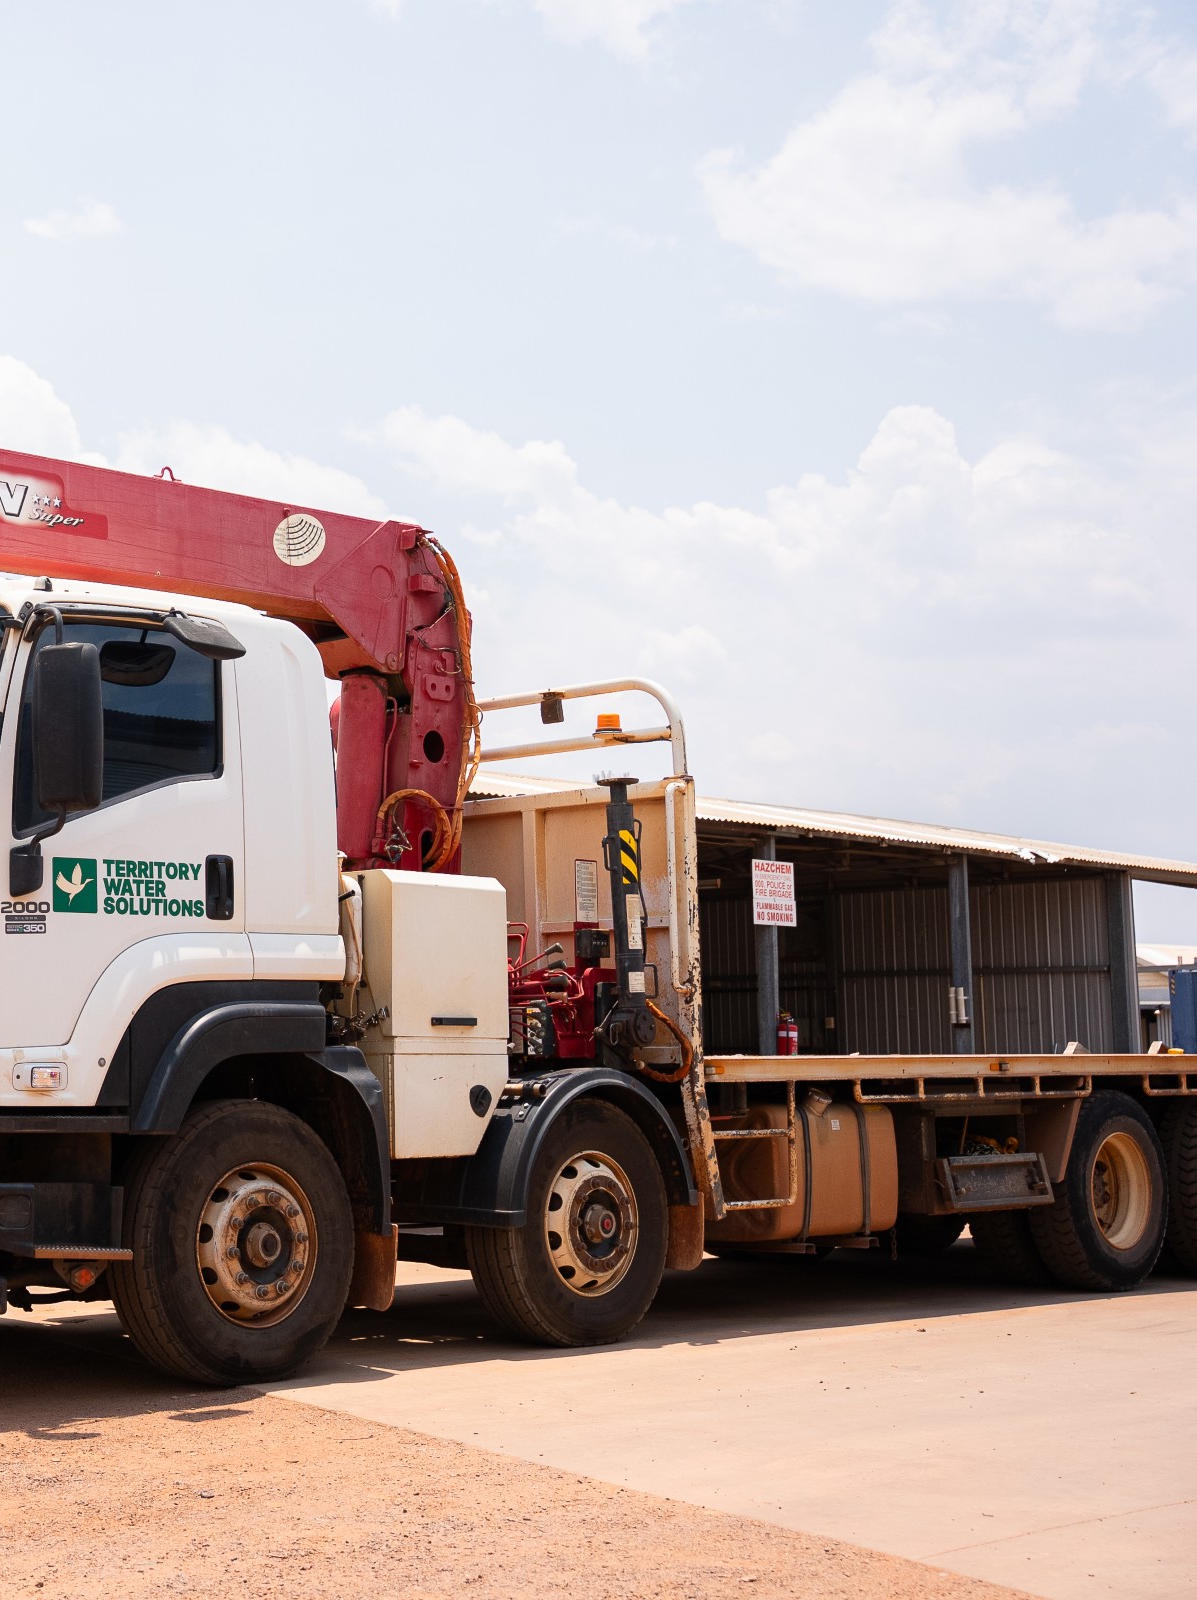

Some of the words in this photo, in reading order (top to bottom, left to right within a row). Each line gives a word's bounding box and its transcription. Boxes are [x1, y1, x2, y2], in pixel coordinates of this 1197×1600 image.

[29, 507, 84, 528] Super
[102, 859, 202, 881] TERRITORY
[754, 862, 792, 874] HAZCHEM
[103, 878, 166, 897] WATER
[767, 881, 786, 890] POLICE
[755, 888, 767, 897] FIRE
[769, 890, 792, 898] BRIGADE
[0, 901, 51, 914] 2000
[103, 897, 204, 917] SOLUTIONS
[756, 902, 783, 910] FLAMMABLE
[757, 912, 764, 920] NO
[767, 912, 793, 922] SMOKING
[23, 923, 45, 933] 350
